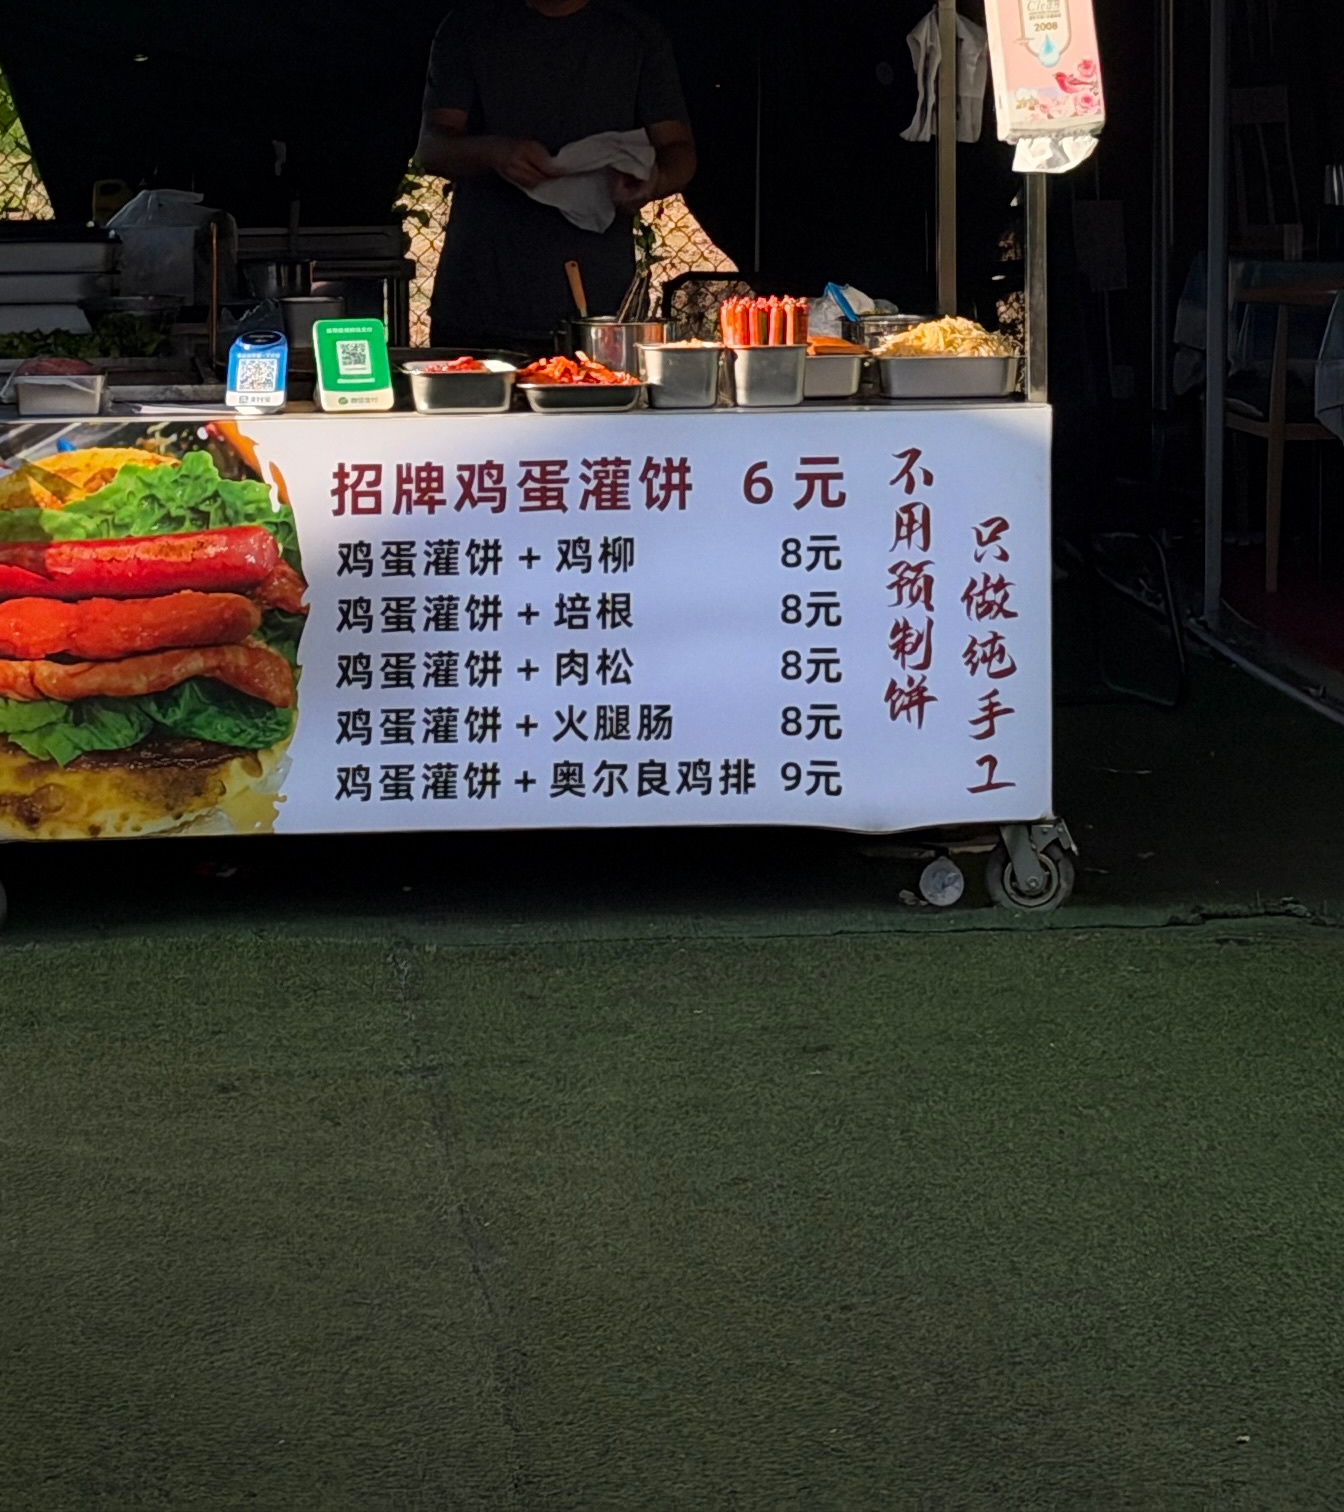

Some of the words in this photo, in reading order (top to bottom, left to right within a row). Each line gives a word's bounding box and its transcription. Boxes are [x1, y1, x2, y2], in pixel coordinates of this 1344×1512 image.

[332, 457, 694, 516] 招牌鸡蛋灌饼
[780, 536, 843, 572] 8元
[883, 447, 937, 730] 不用预制饼
[780, 592, 843, 629] 8元
[780, 649, 843, 686] 8元
[962, 516, 1019, 795] 只做纯手工
[780, 705, 843, 742] 8元
[780, 761, 843, 797] 9元
